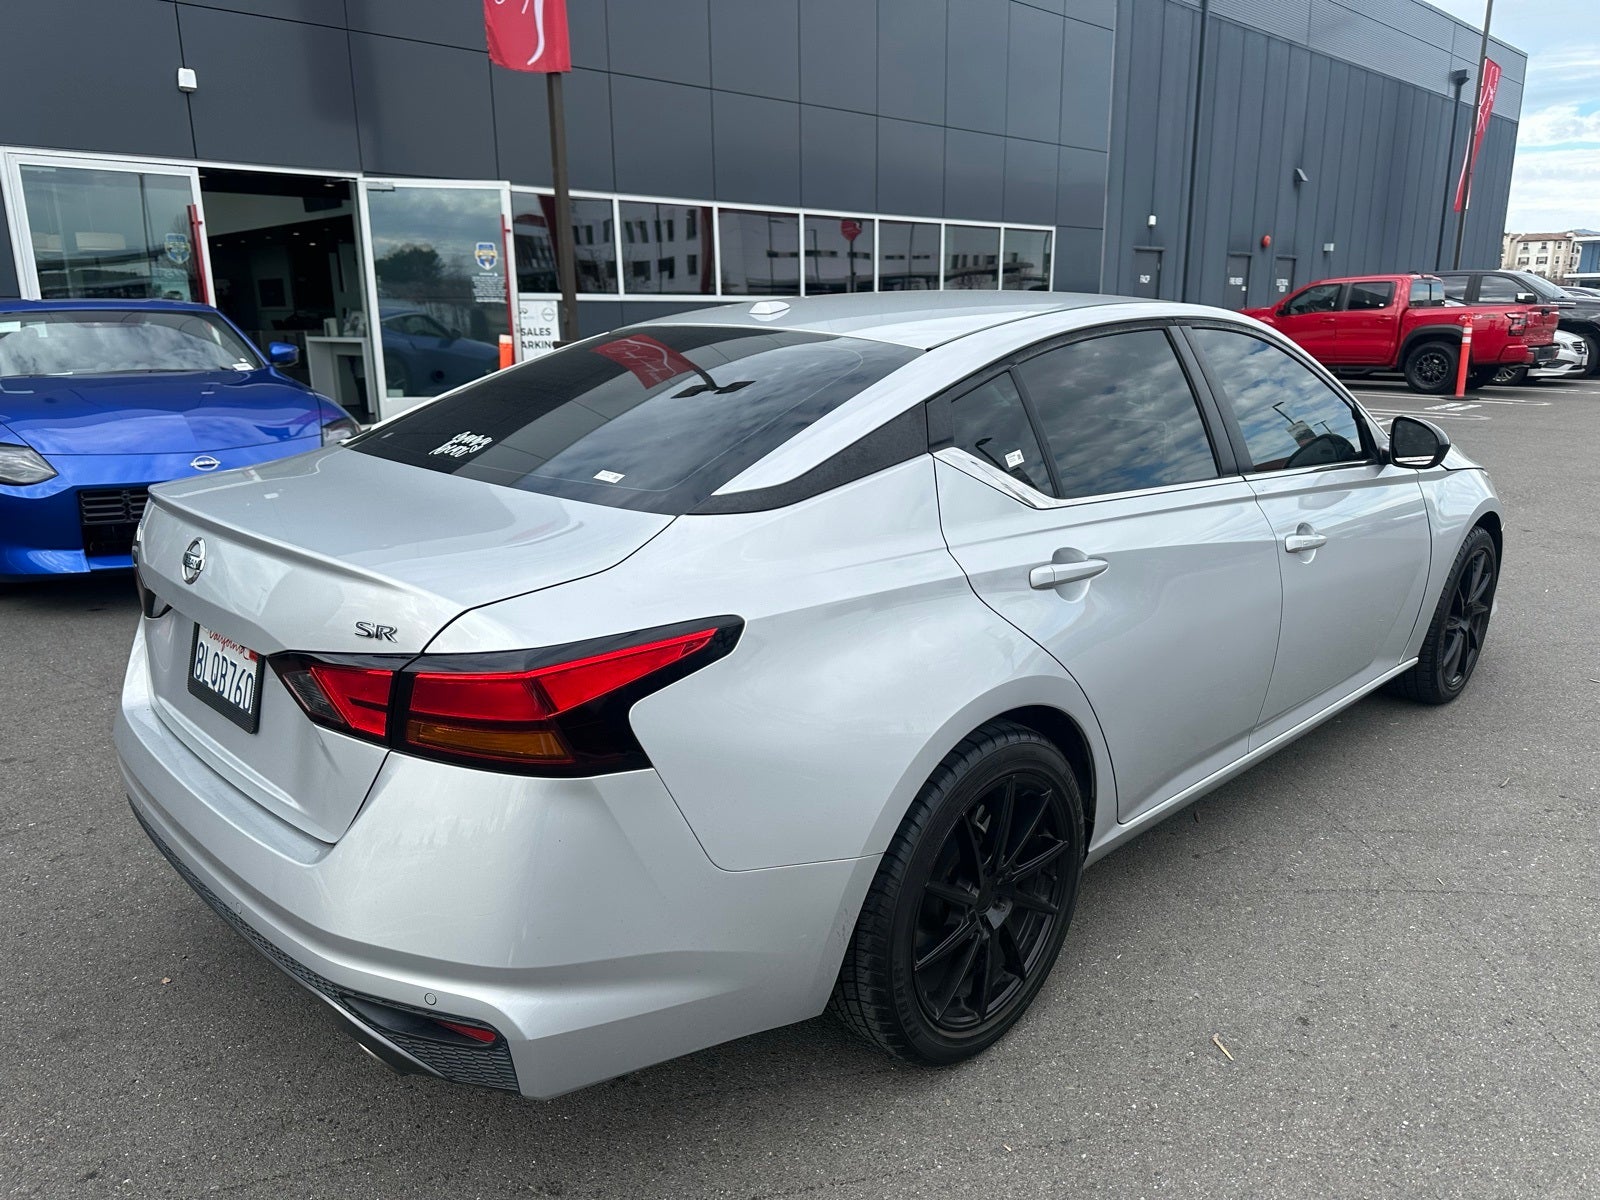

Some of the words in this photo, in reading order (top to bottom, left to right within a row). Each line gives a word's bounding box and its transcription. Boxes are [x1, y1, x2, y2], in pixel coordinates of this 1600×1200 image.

[520, 327, 552, 337] SALES
[521, 341, 554, 349] ARKIN
[354, 621, 399, 643] SR
[194, 641, 254, 711] 8LQB760
